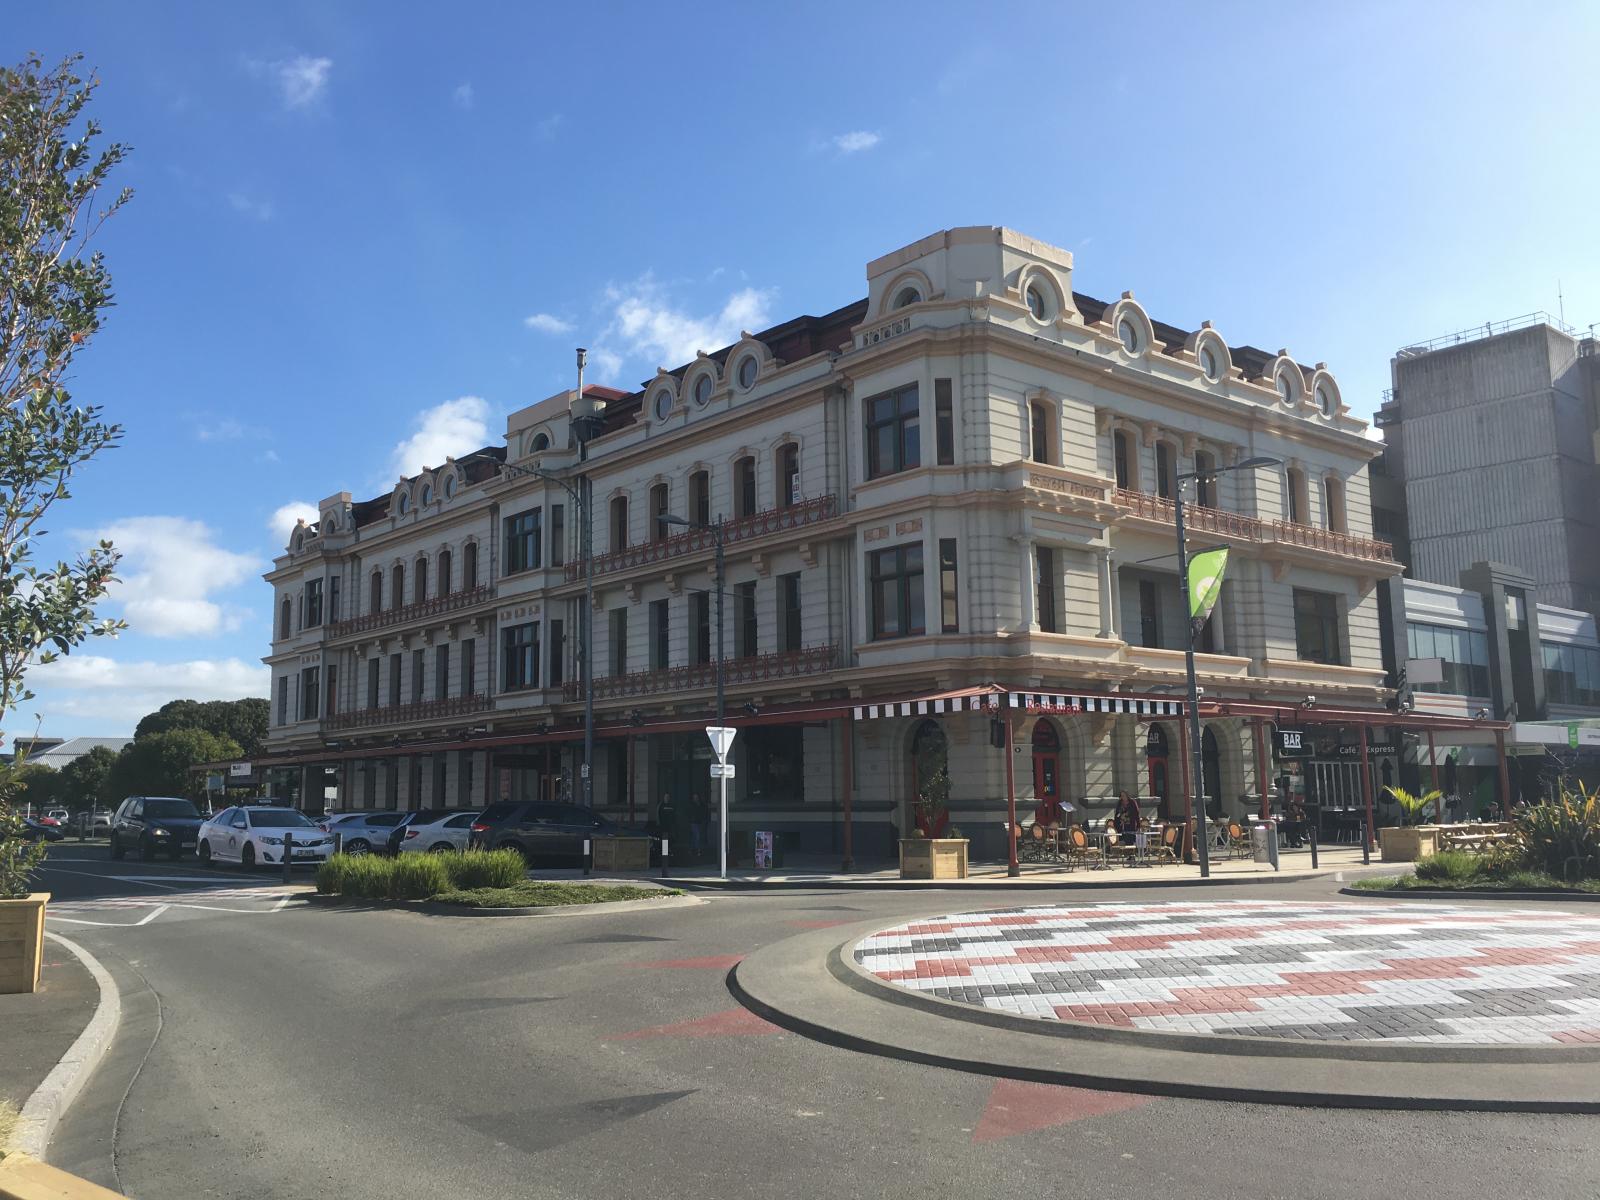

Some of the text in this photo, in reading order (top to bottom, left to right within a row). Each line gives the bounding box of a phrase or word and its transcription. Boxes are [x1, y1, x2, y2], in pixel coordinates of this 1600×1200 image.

[1027, 699, 1083, 714] Restaurant
[1284, 733, 1301, 747] BAR
[1366, 745, 1395, 755] Express
